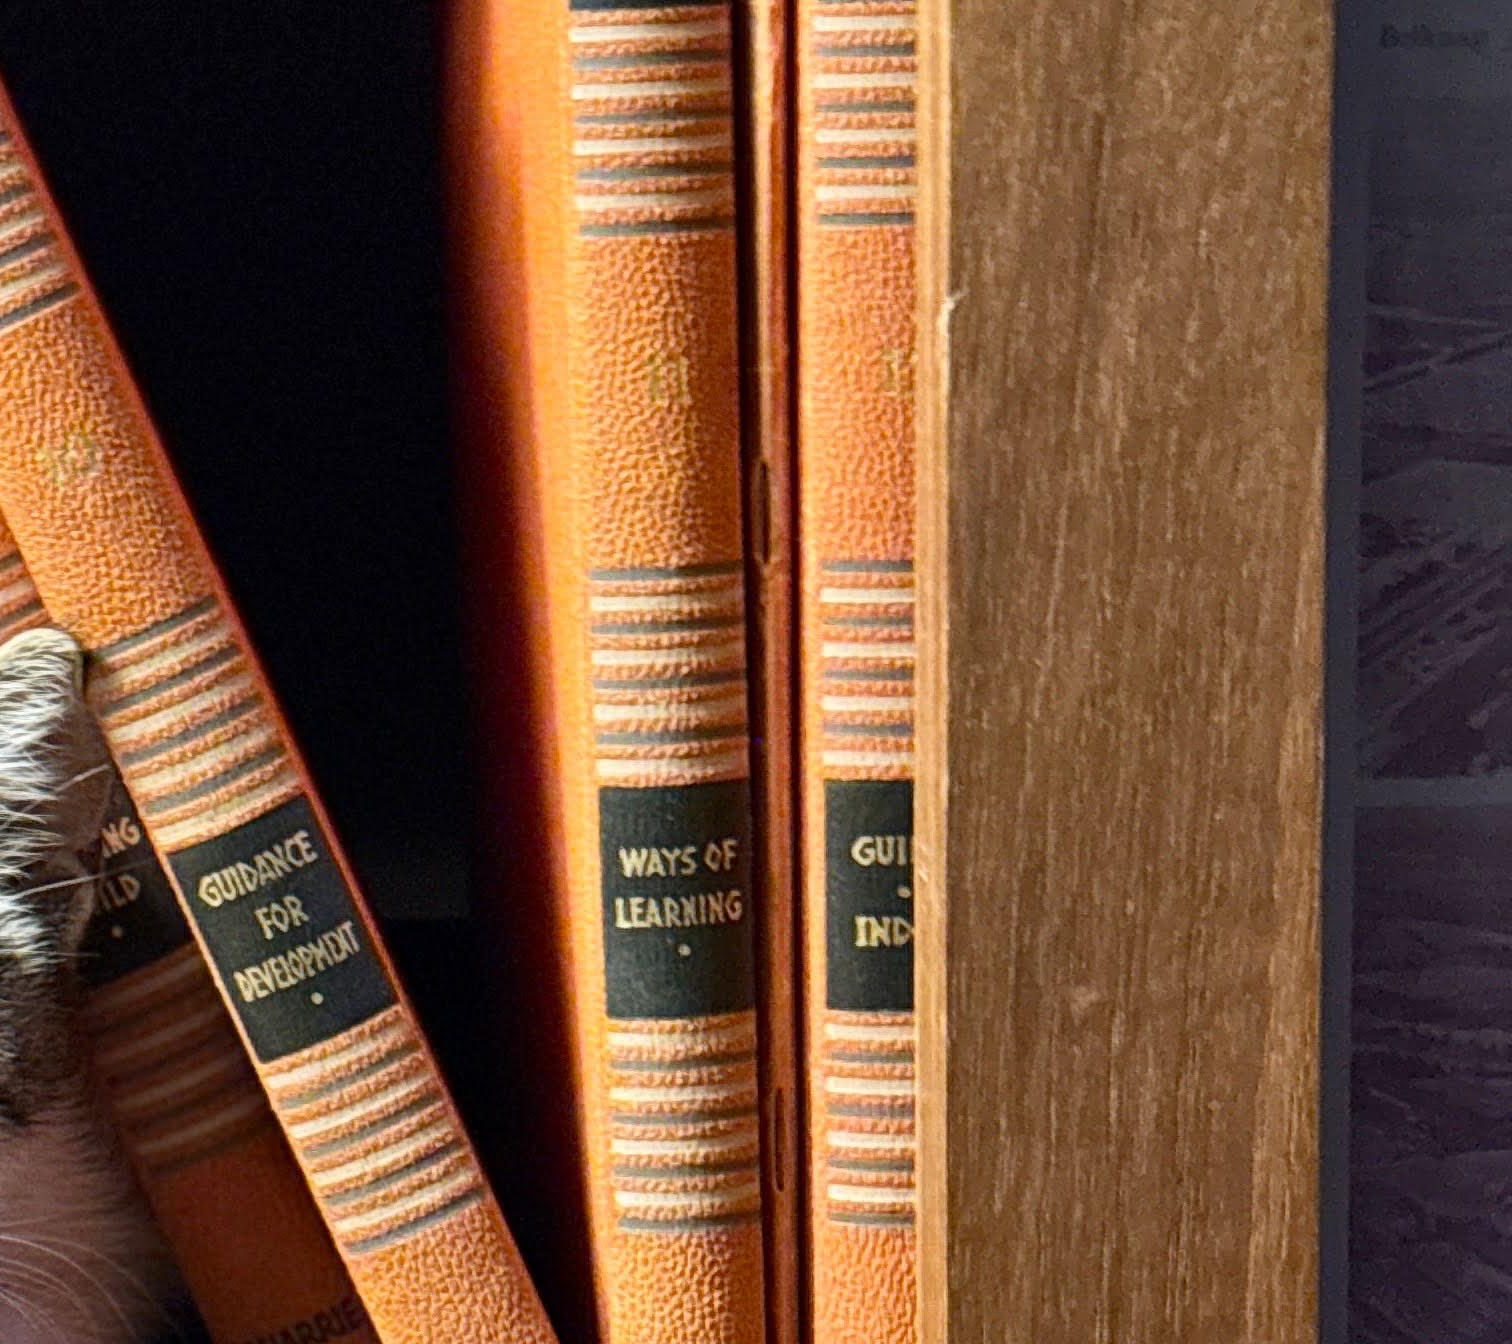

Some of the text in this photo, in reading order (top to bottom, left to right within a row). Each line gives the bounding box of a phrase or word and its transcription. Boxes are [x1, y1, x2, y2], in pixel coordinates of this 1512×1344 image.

[197, 829, 319, 908] GUIDANCE
[617, 838, 738, 879] WAYS OF
[851, 834, 915, 867] GUI
[254, 895, 311, 941] FOR
[613, 890, 743, 930] LEARNING
[854, 915, 915, 948] IND
[232, 919, 362, 1003] DEVELOPMENT
